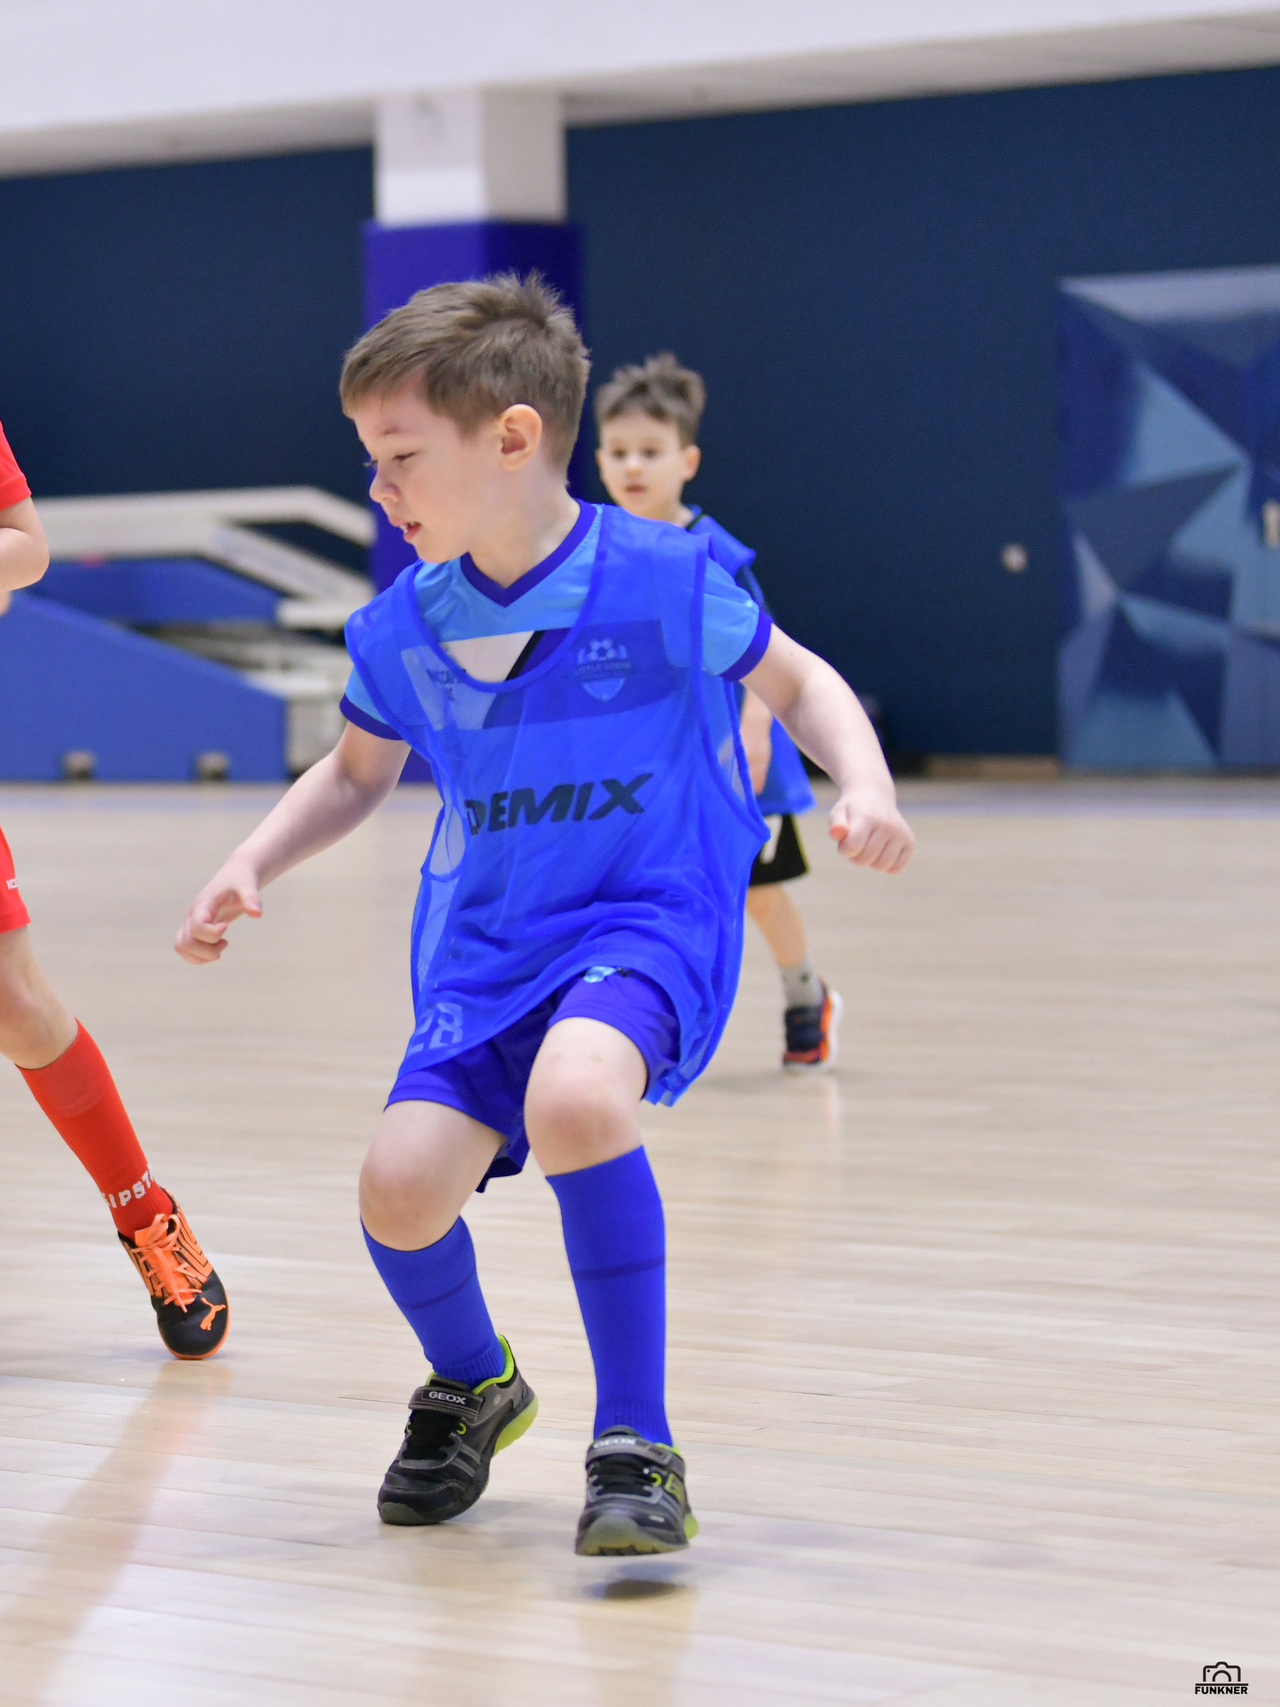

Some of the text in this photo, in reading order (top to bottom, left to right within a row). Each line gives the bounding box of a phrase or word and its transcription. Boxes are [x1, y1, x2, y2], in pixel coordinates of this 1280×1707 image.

[464, 772, 654, 836] DEMIX
[101, 1164, 154, 1208] IPST
[428, 1390, 467, 1405] GEOX
